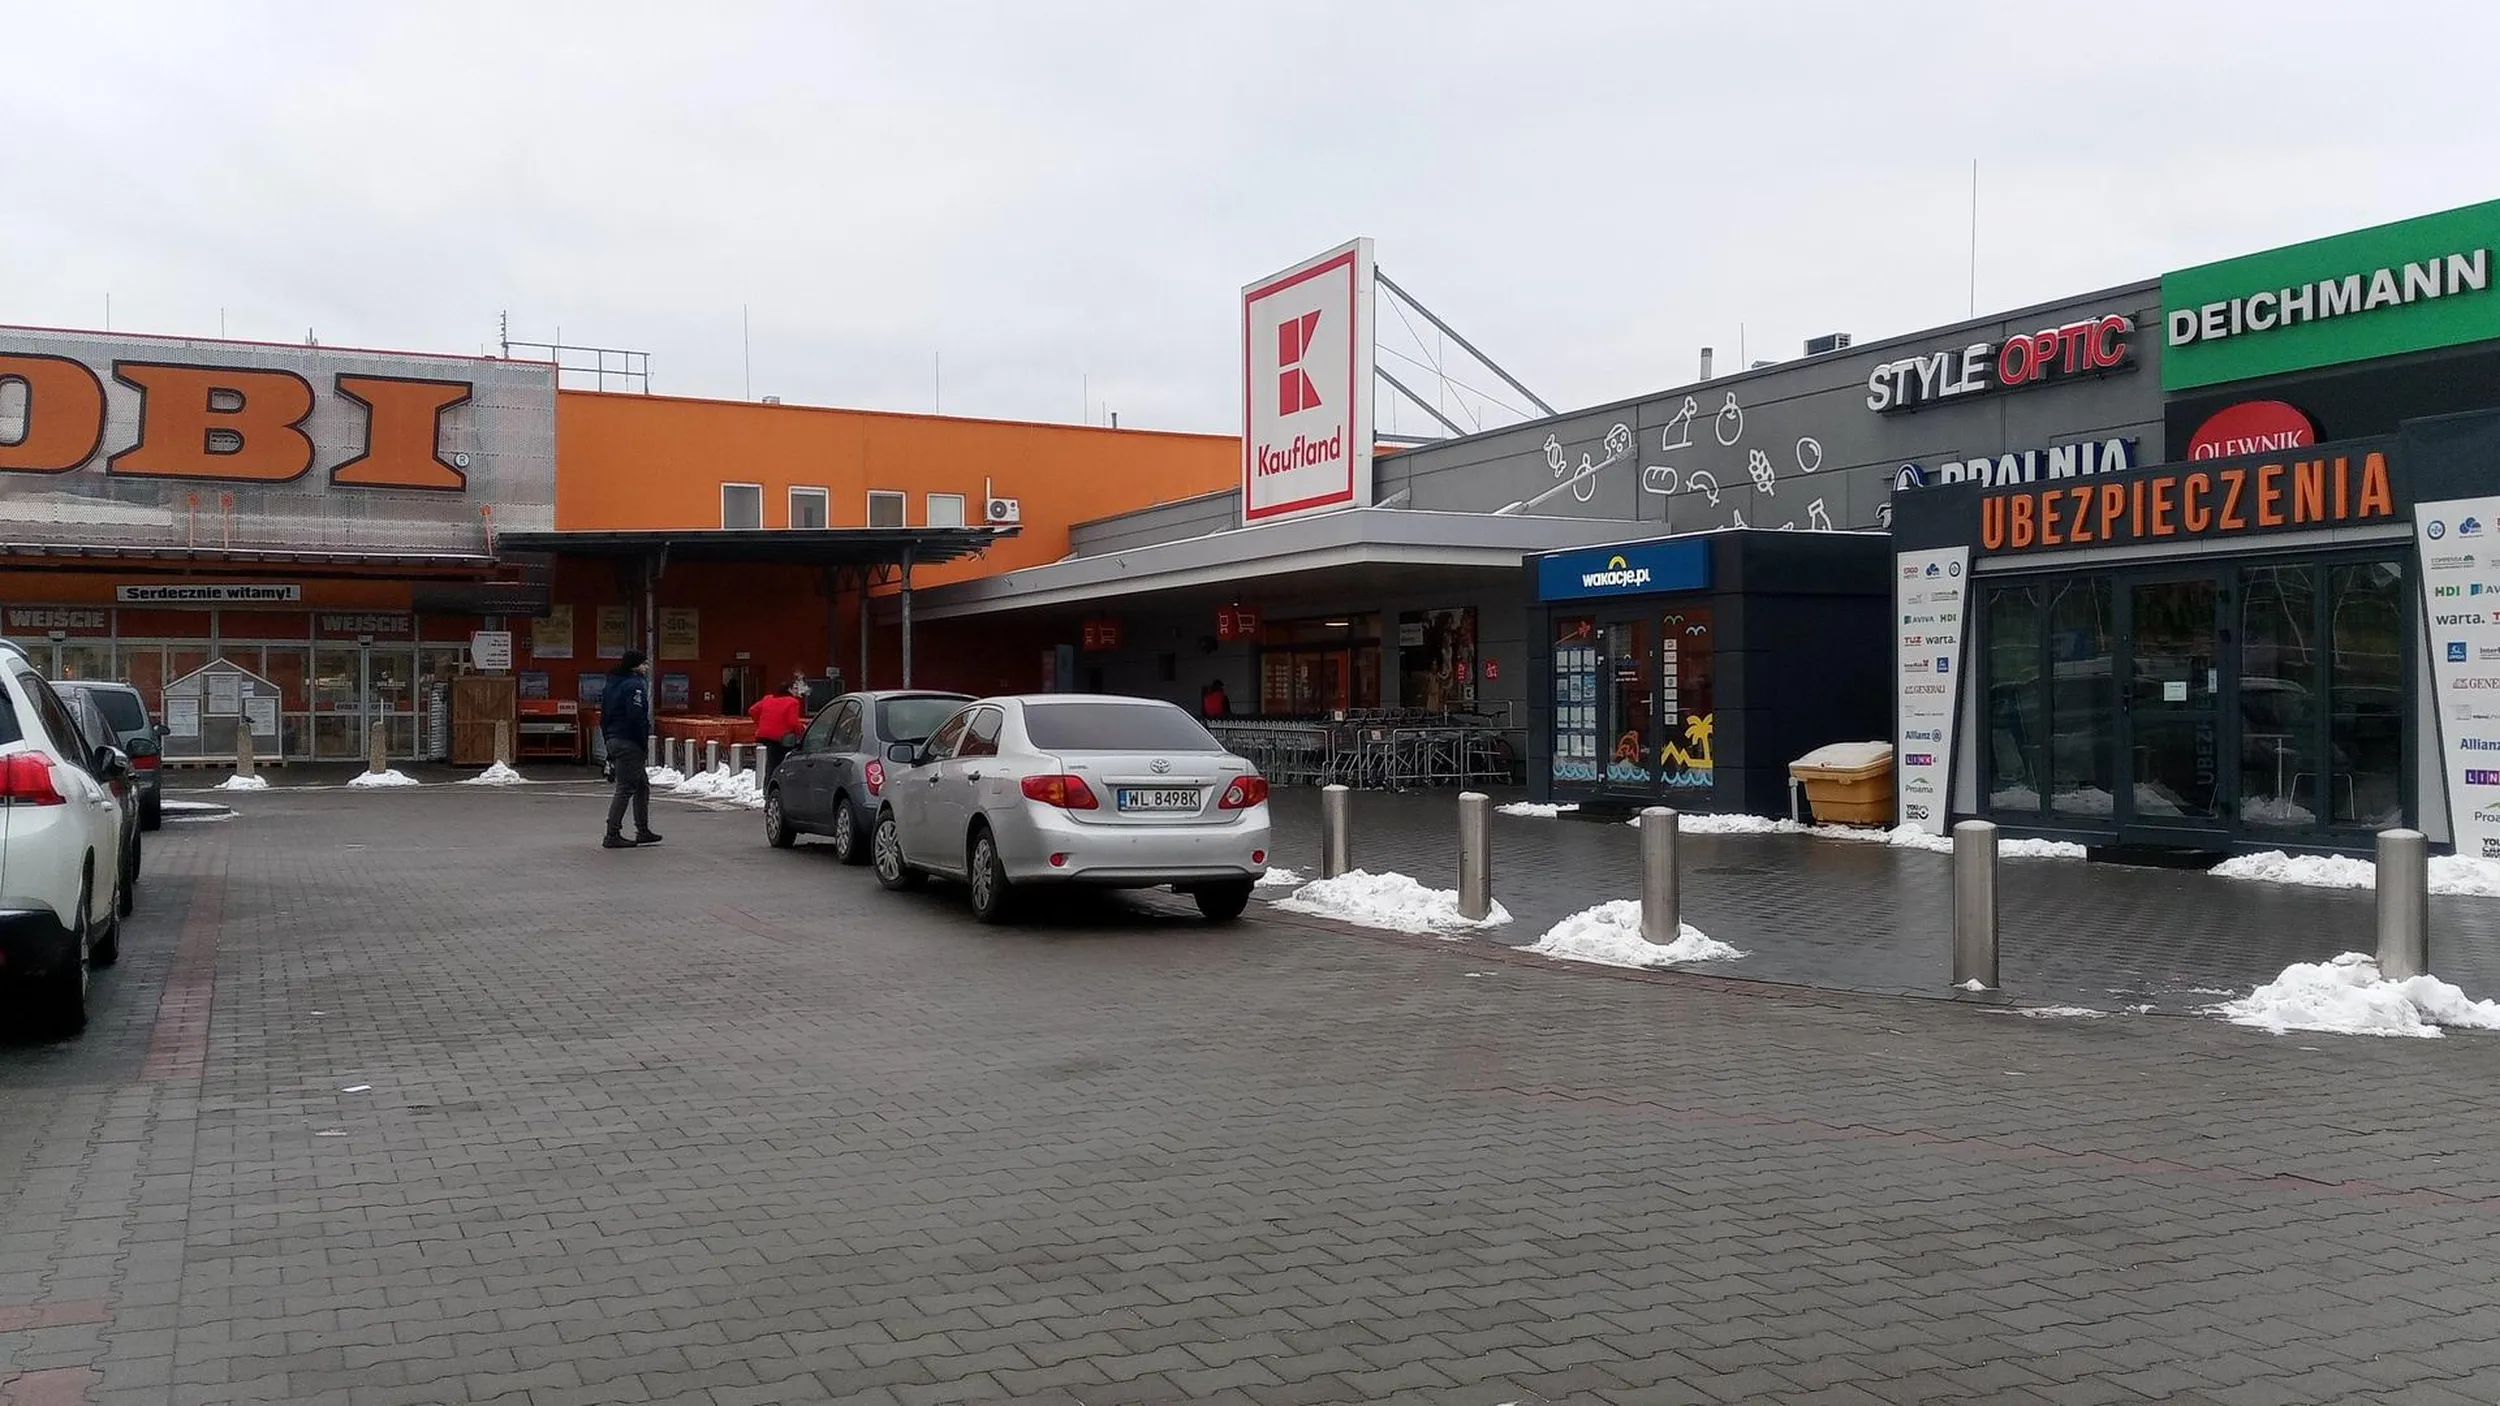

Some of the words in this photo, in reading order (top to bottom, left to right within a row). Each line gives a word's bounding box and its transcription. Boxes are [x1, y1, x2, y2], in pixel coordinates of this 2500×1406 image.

[2168, 249, 2487, 346] DEICHMANN
[1866, 343, 1991, 412] STYLE
[1999, 315, 2129, 386] OPTIC
[1258, 425, 1341, 477] Kaufland
[2194, 430, 2304, 461] OLEWNIK
[1980, 452, 2396, 550] UBEZPIECZENIA
[1582, 568, 1652, 587] wakacje.pl
[126, 586, 222, 600] Serdecznie
[226, 586, 292, 601] witamy!
[2435, 586, 2460, 597] HDI
[9, 606, 106, 627] WEJŚCIE
[321, 612, 410, 632] WEJŚCIE
[1939, 613, 1957, 623] HDI
[2435, 613, 2485, 625] warta.
[1905, 730, 1931, 740] Allianz
[1128, 791, 1150, 806] WL
[1154, 791, 1197, 807] 8498K
[1905, 785, 1934, 794] Proama
